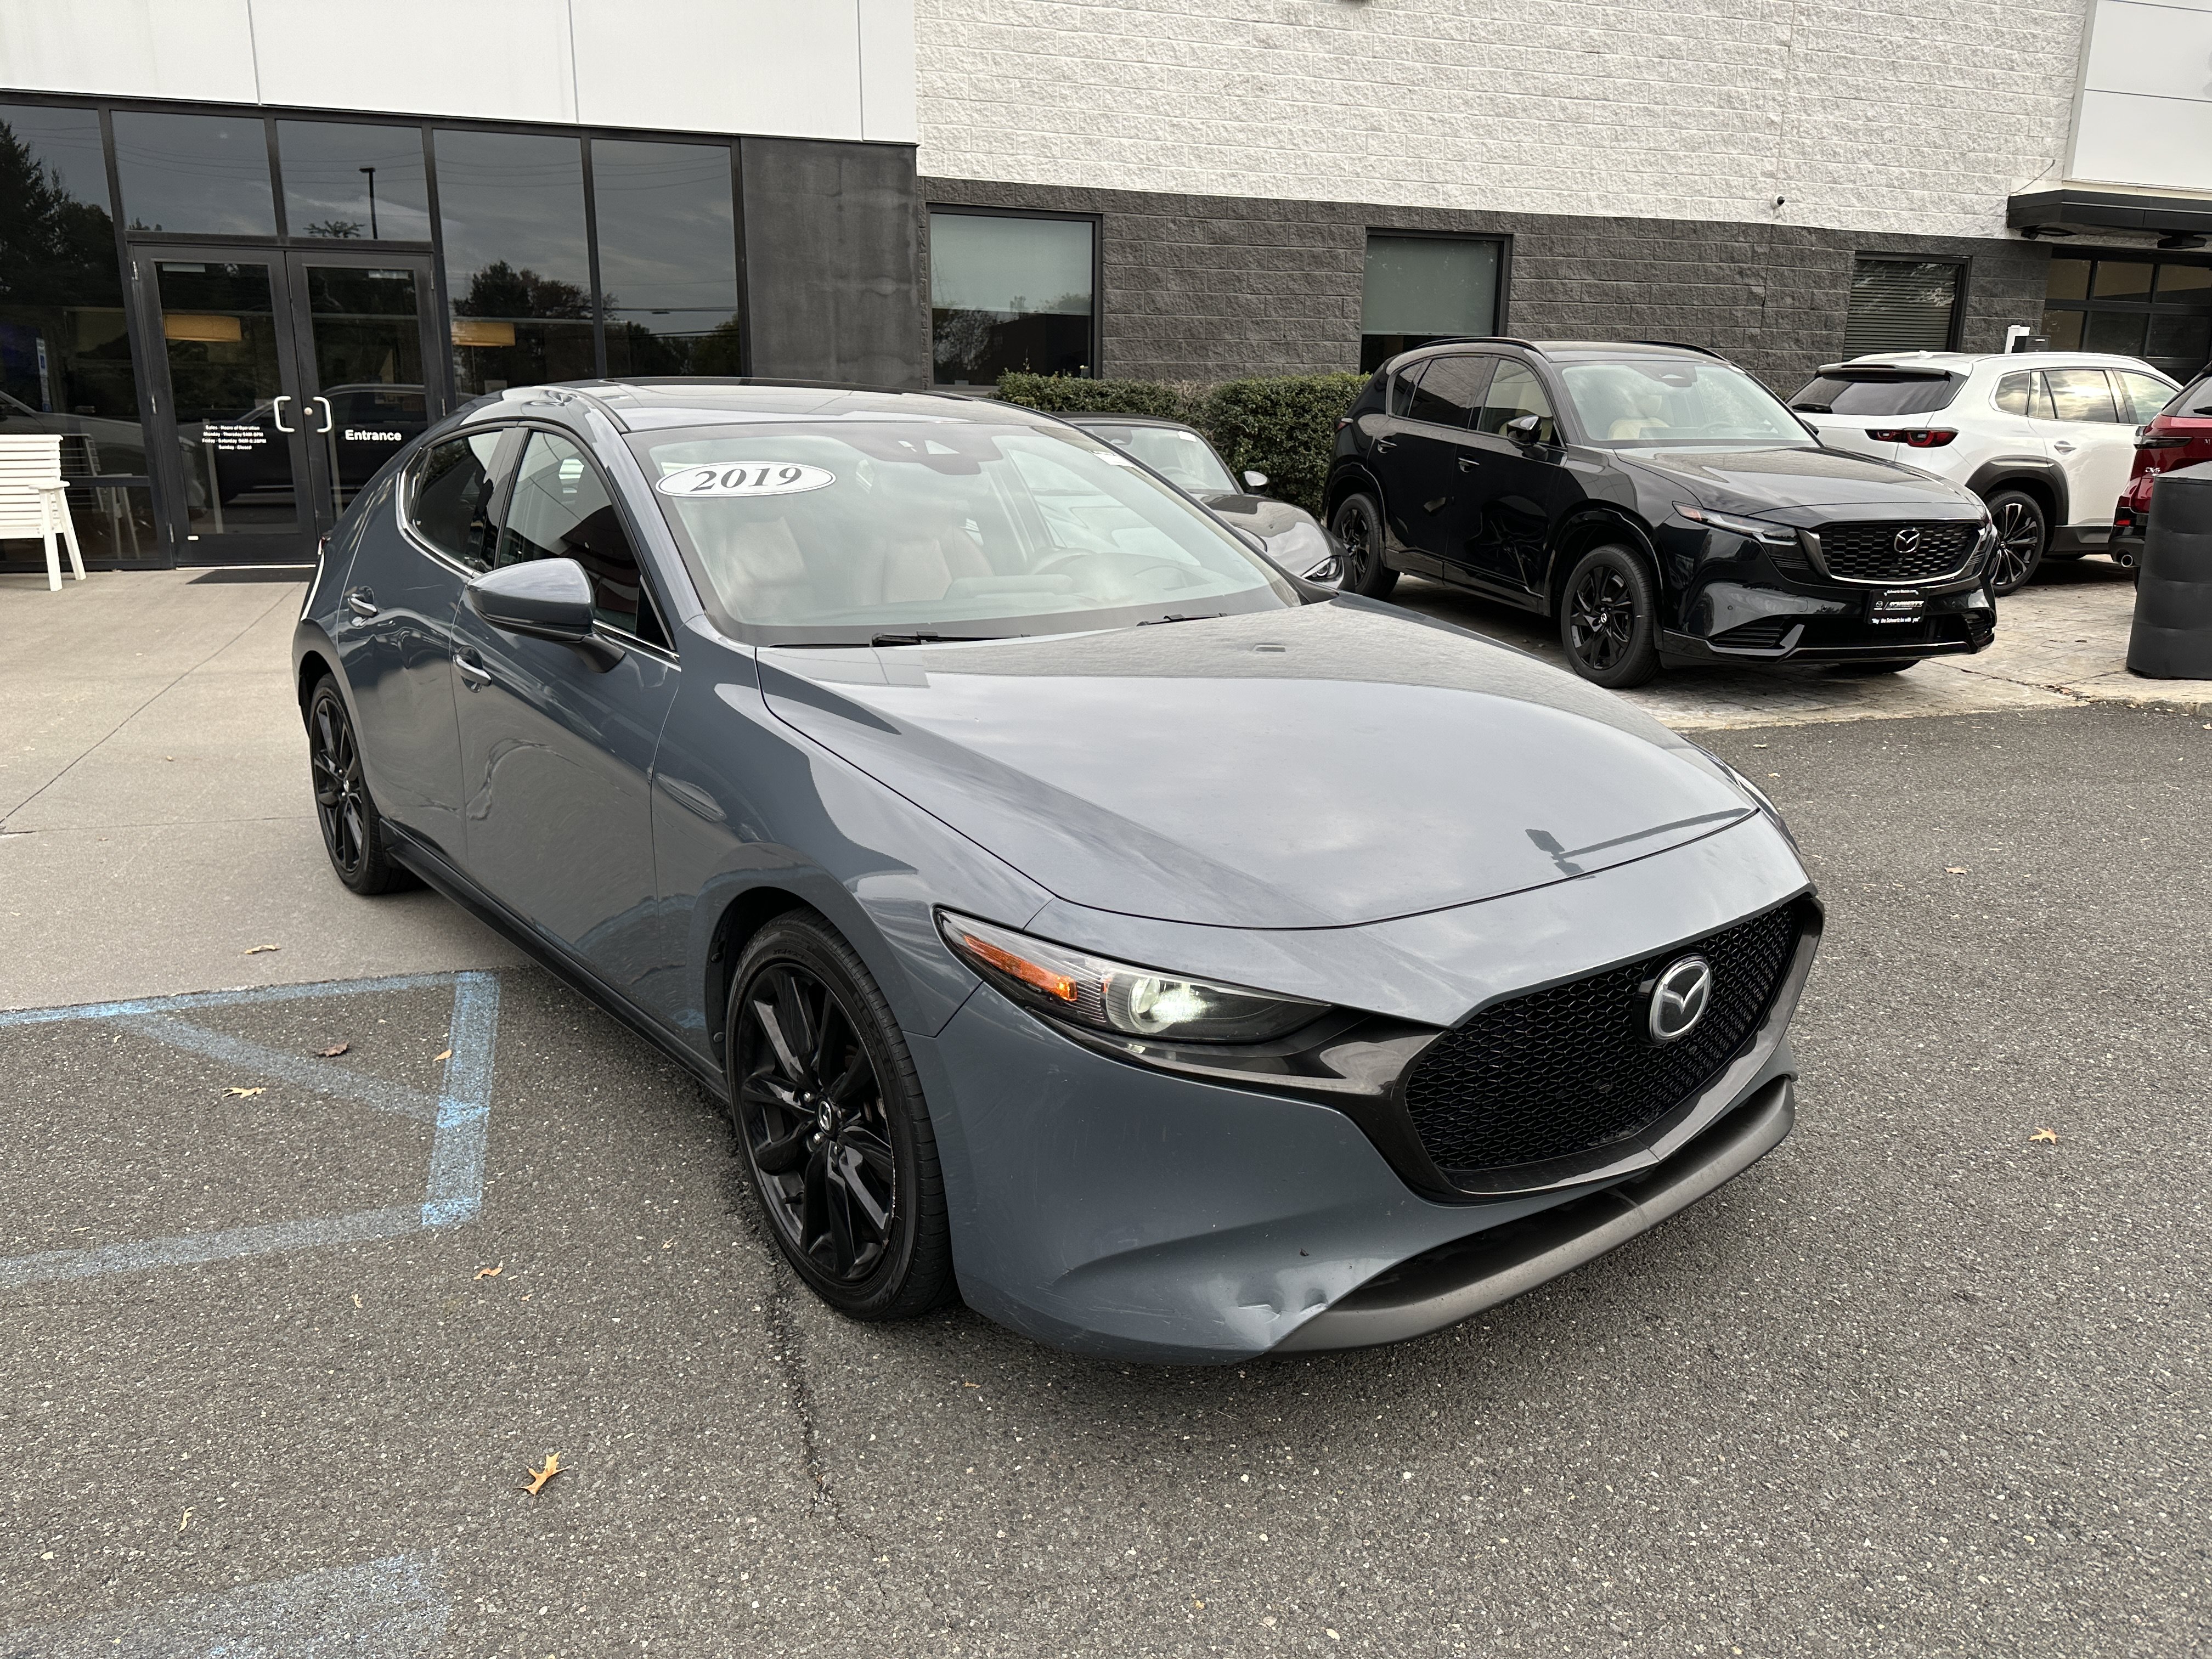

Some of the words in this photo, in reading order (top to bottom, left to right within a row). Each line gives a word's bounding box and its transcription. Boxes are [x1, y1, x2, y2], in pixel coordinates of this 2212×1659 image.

[345, 429, 402, 441] Entrance
[690, 467, 802, 492] 2019
[853, 991, 896, 1081] NEXEN
